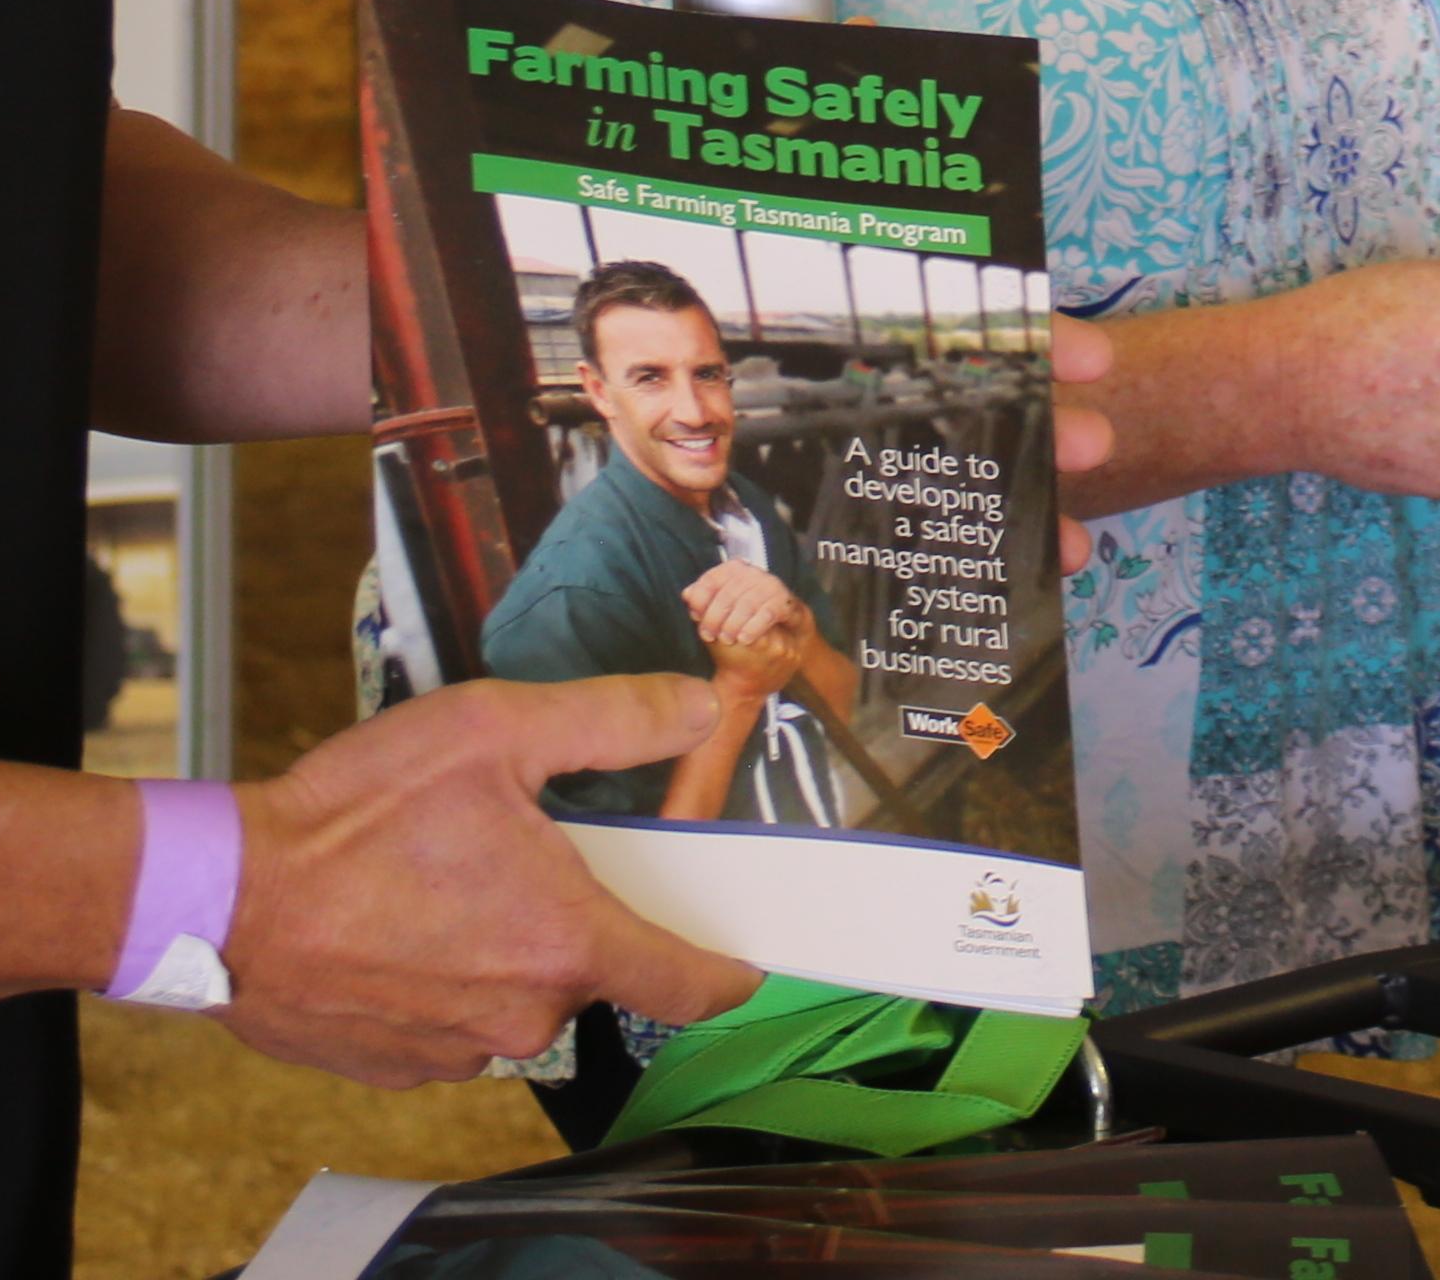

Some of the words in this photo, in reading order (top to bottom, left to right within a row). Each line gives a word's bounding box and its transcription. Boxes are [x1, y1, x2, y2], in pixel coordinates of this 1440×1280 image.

[468, 27, 749, 118] Farming
[764, 66, 983, 139] Safely
[586, 107, 638, 152] in
[654, 109, 984, 192] Tasmania
[577, 175, 629, 204] Safe
[636, 185, 737, 226] Farming
[738, 198, 853, 235] Tasmania
[859, 212, 967, 248] Program
[844, 437, 872, 466] A
[880, 444, 959, 477] guide
[965, 453, 1000, 480] to
[844, 470, 1004, 522] developing
[895, 516, 913, 538] a
[921, 515, 1004, 555] safety
[817, 540, 1008, 583] management
[907, 586, 1008, 616] system
[888, 609, 934, 640] for
[940, 622, 1009, 651] rural
[861, 639, 1013, 686] businesses
[953, 940, 1042, 959] Government
[958, 924, 1034, 943] Tasmanian
